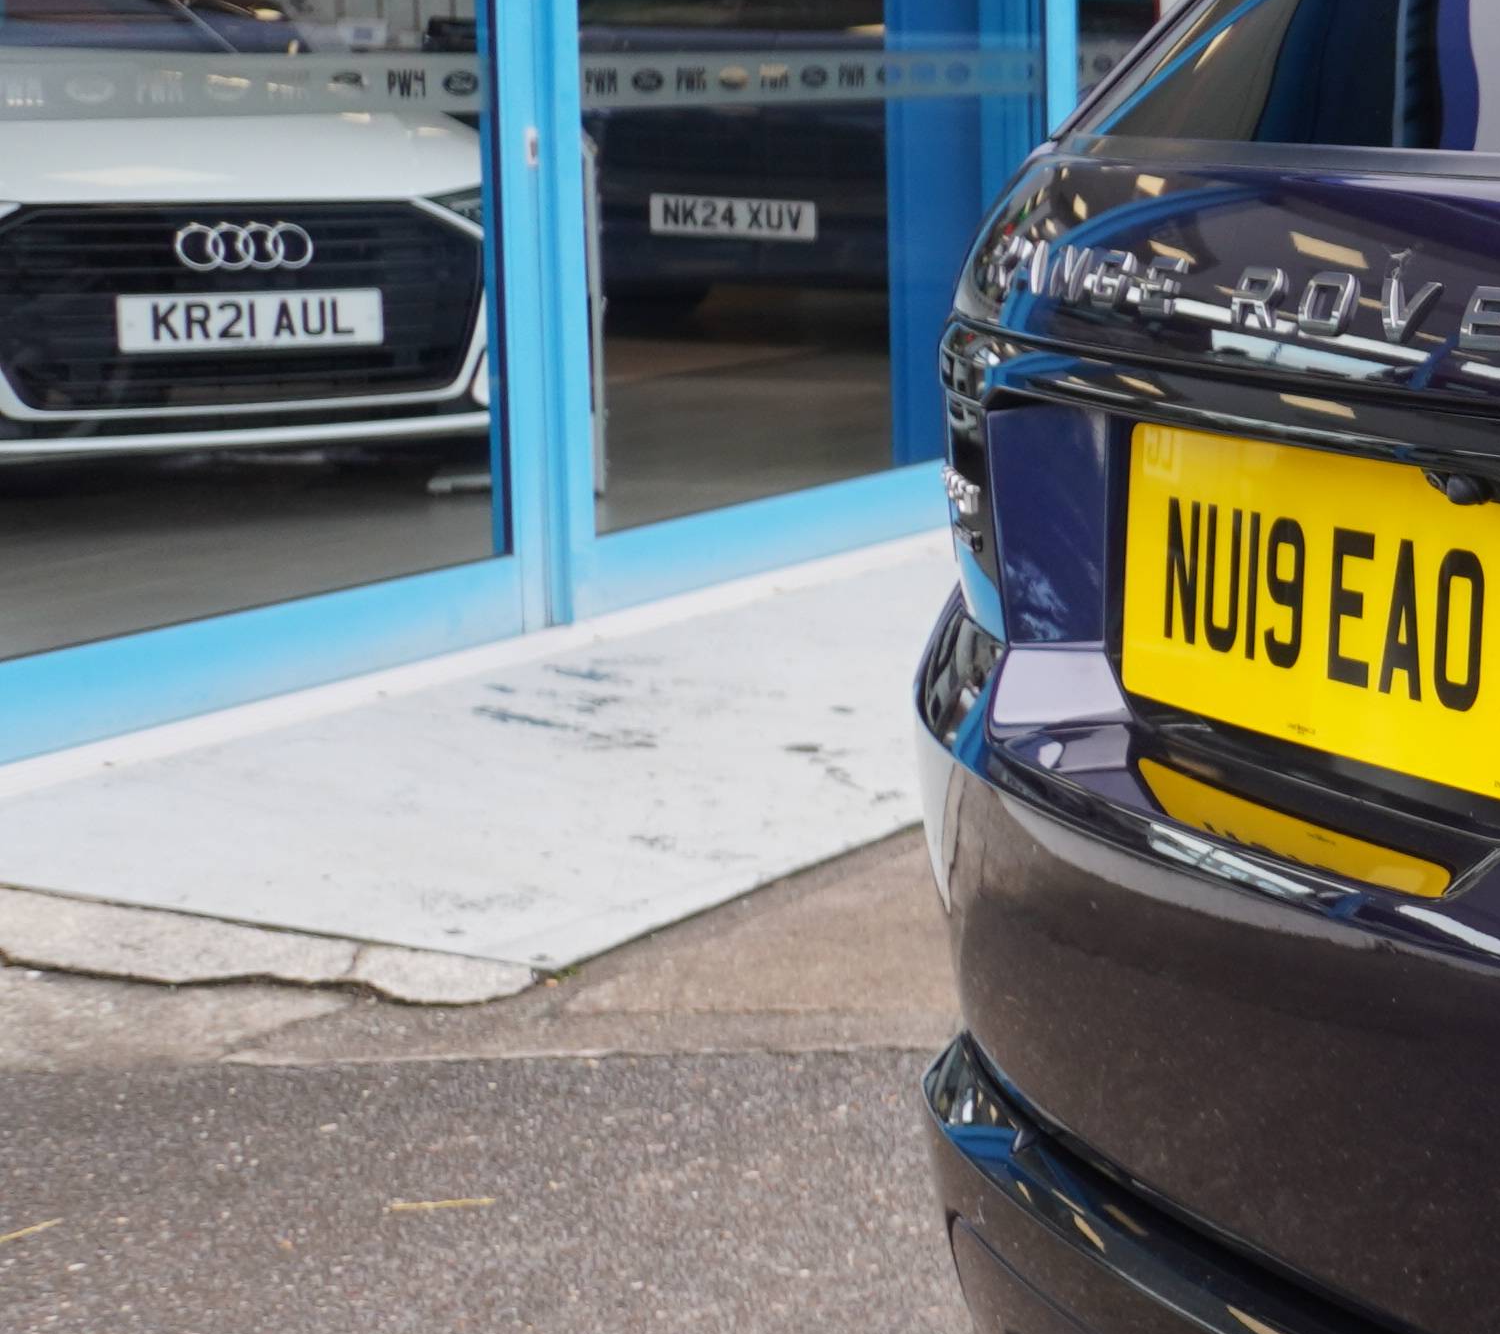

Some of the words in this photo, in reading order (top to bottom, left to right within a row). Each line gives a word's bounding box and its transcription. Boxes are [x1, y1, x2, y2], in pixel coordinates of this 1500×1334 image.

[663, 198, 736, 228] NK24
[747, 201, 802, 232] XUV
[151, 302, 257, 341] KR21
[274, 298, 355, 338] AUL
[1163, 497, 1306, 670] NU19
[1327, 527, 1485, 712] EAO
